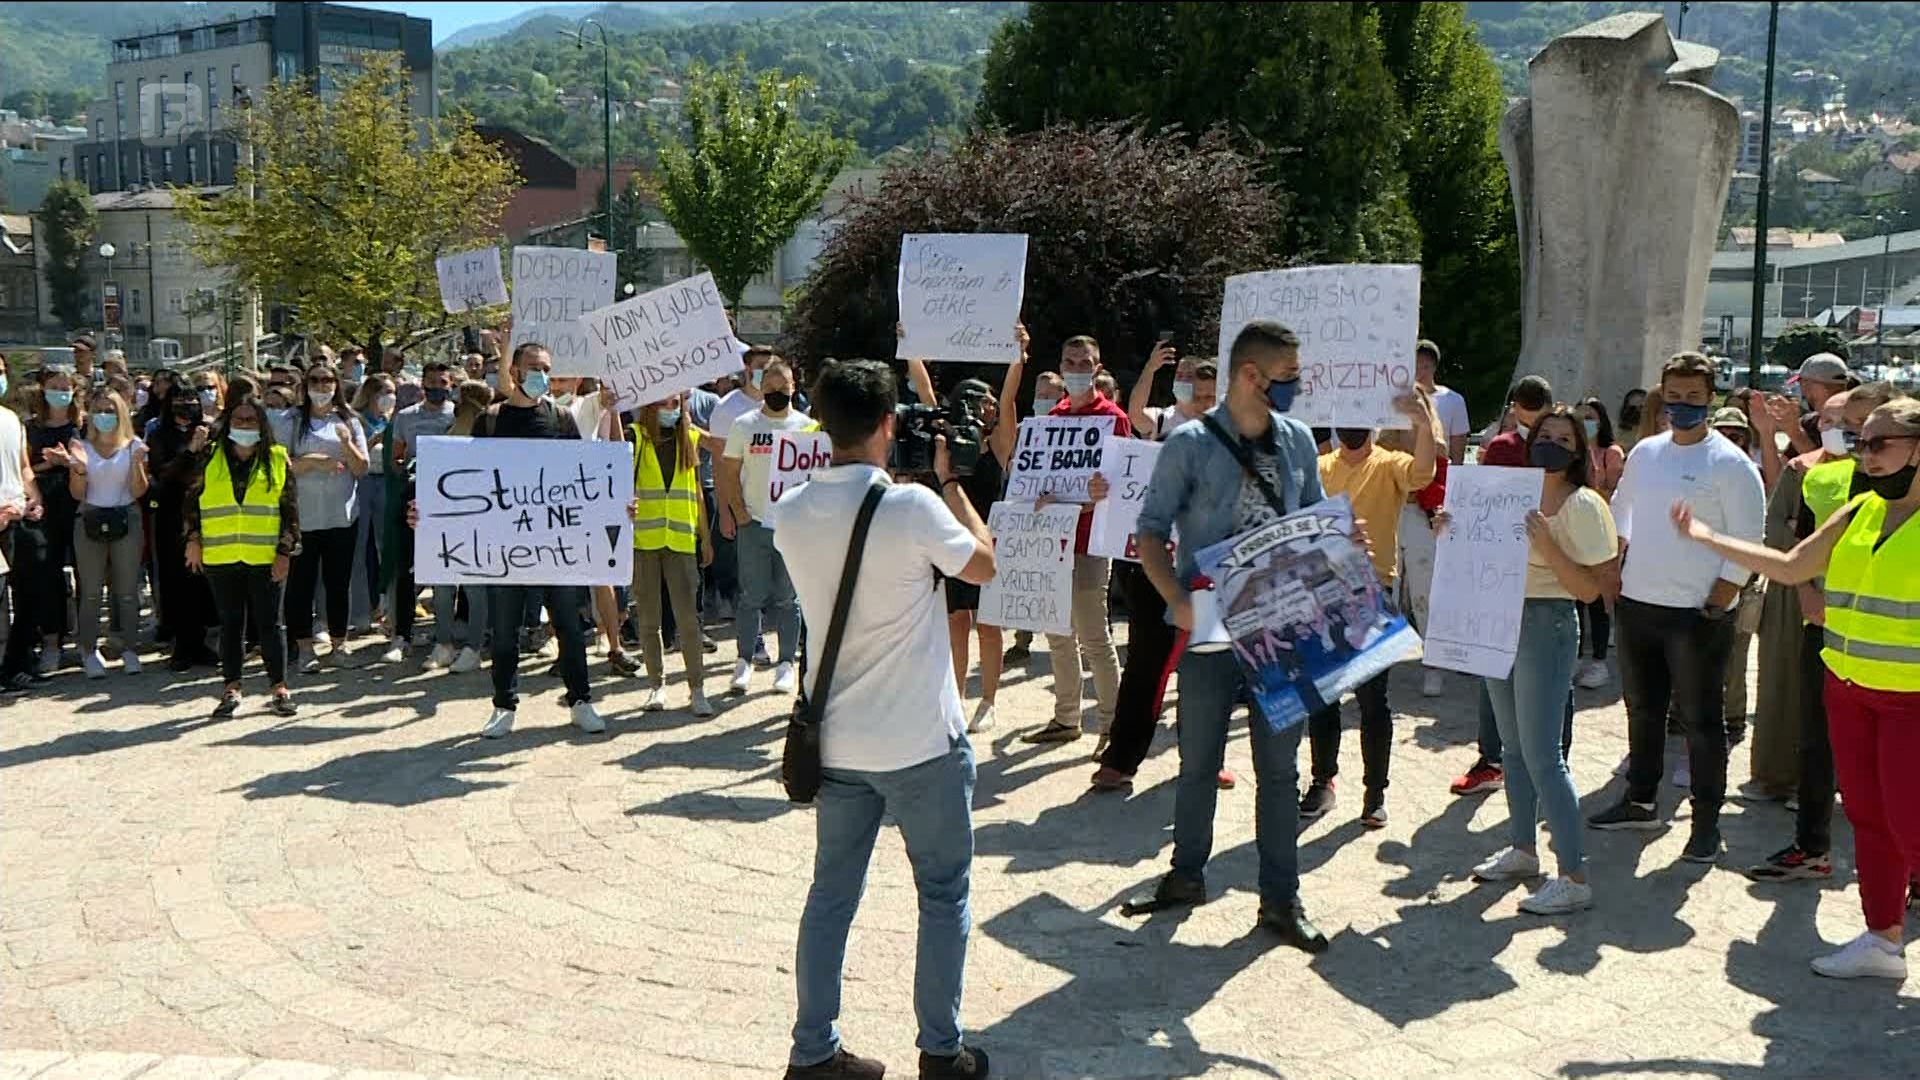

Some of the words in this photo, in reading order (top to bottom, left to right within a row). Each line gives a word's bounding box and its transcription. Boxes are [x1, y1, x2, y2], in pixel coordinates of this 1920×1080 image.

[1325, 284, 1381, 307] SMO
[590, 305, 653, 347] VIDIM
[1320, 318, 1357, 342] OD
[605, 345, 637, 376] ALI
[643, 330, 679, 355] NE
[750, 433, 773, 446] JUS
[1024, 427, 1034, 447] I
[1045, 427, 1100, 446] TITO
[1017, 449, 1045, 472] SE
[1050, 448, 1102, 471] BOJAO
[1121, 455, 1140, 477] I
[427, 463, 614, 516] Studenti
[1011, 475, 1088, 496] STUDENAT
[512, 509, 533, 532] A
[547, 505, 583, 529] NE
[1000, 569, 1057, 592] VRIJEME
[1000, 594, 1058, 623] IZBORA
